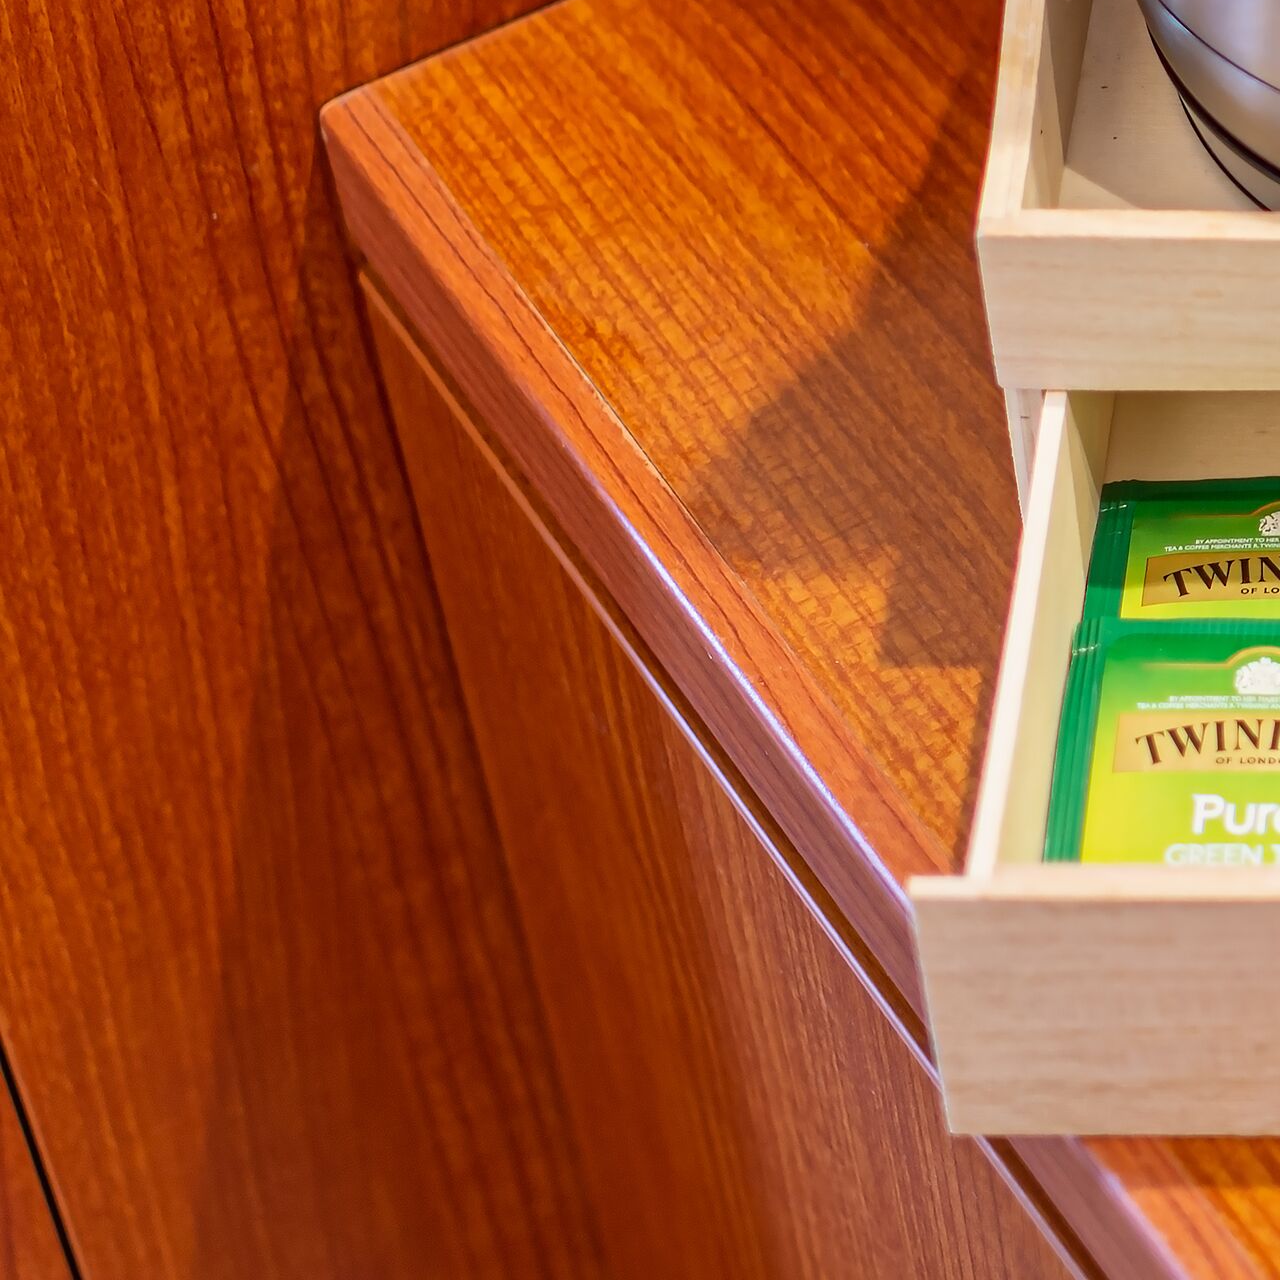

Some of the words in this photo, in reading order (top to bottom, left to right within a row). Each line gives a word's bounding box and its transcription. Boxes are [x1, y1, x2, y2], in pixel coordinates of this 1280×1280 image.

[1240, 587, 1258, 595] OF
[1215, 757, 1234, 765] OF
[1164, 842, 1264, 865] GREEN
